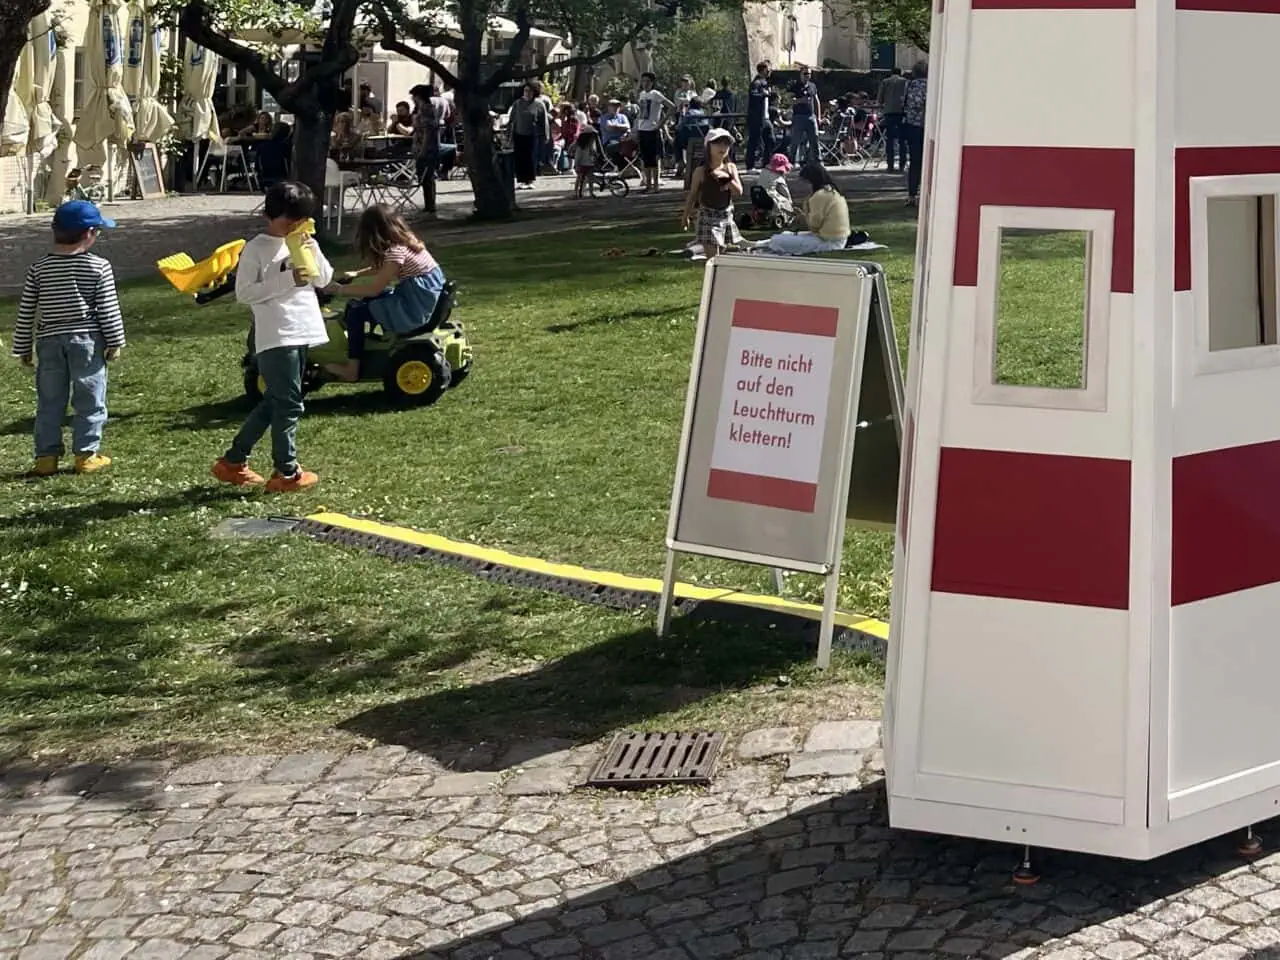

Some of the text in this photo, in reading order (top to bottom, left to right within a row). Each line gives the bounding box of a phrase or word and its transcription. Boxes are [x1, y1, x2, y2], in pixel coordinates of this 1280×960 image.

[741, 349, 813, 373] Bitte nicht
[736, 376, 794, 397] auf den
[733, 400, 815, 426] Leuchtturm
[729, 422, 792, 449] klettern!
